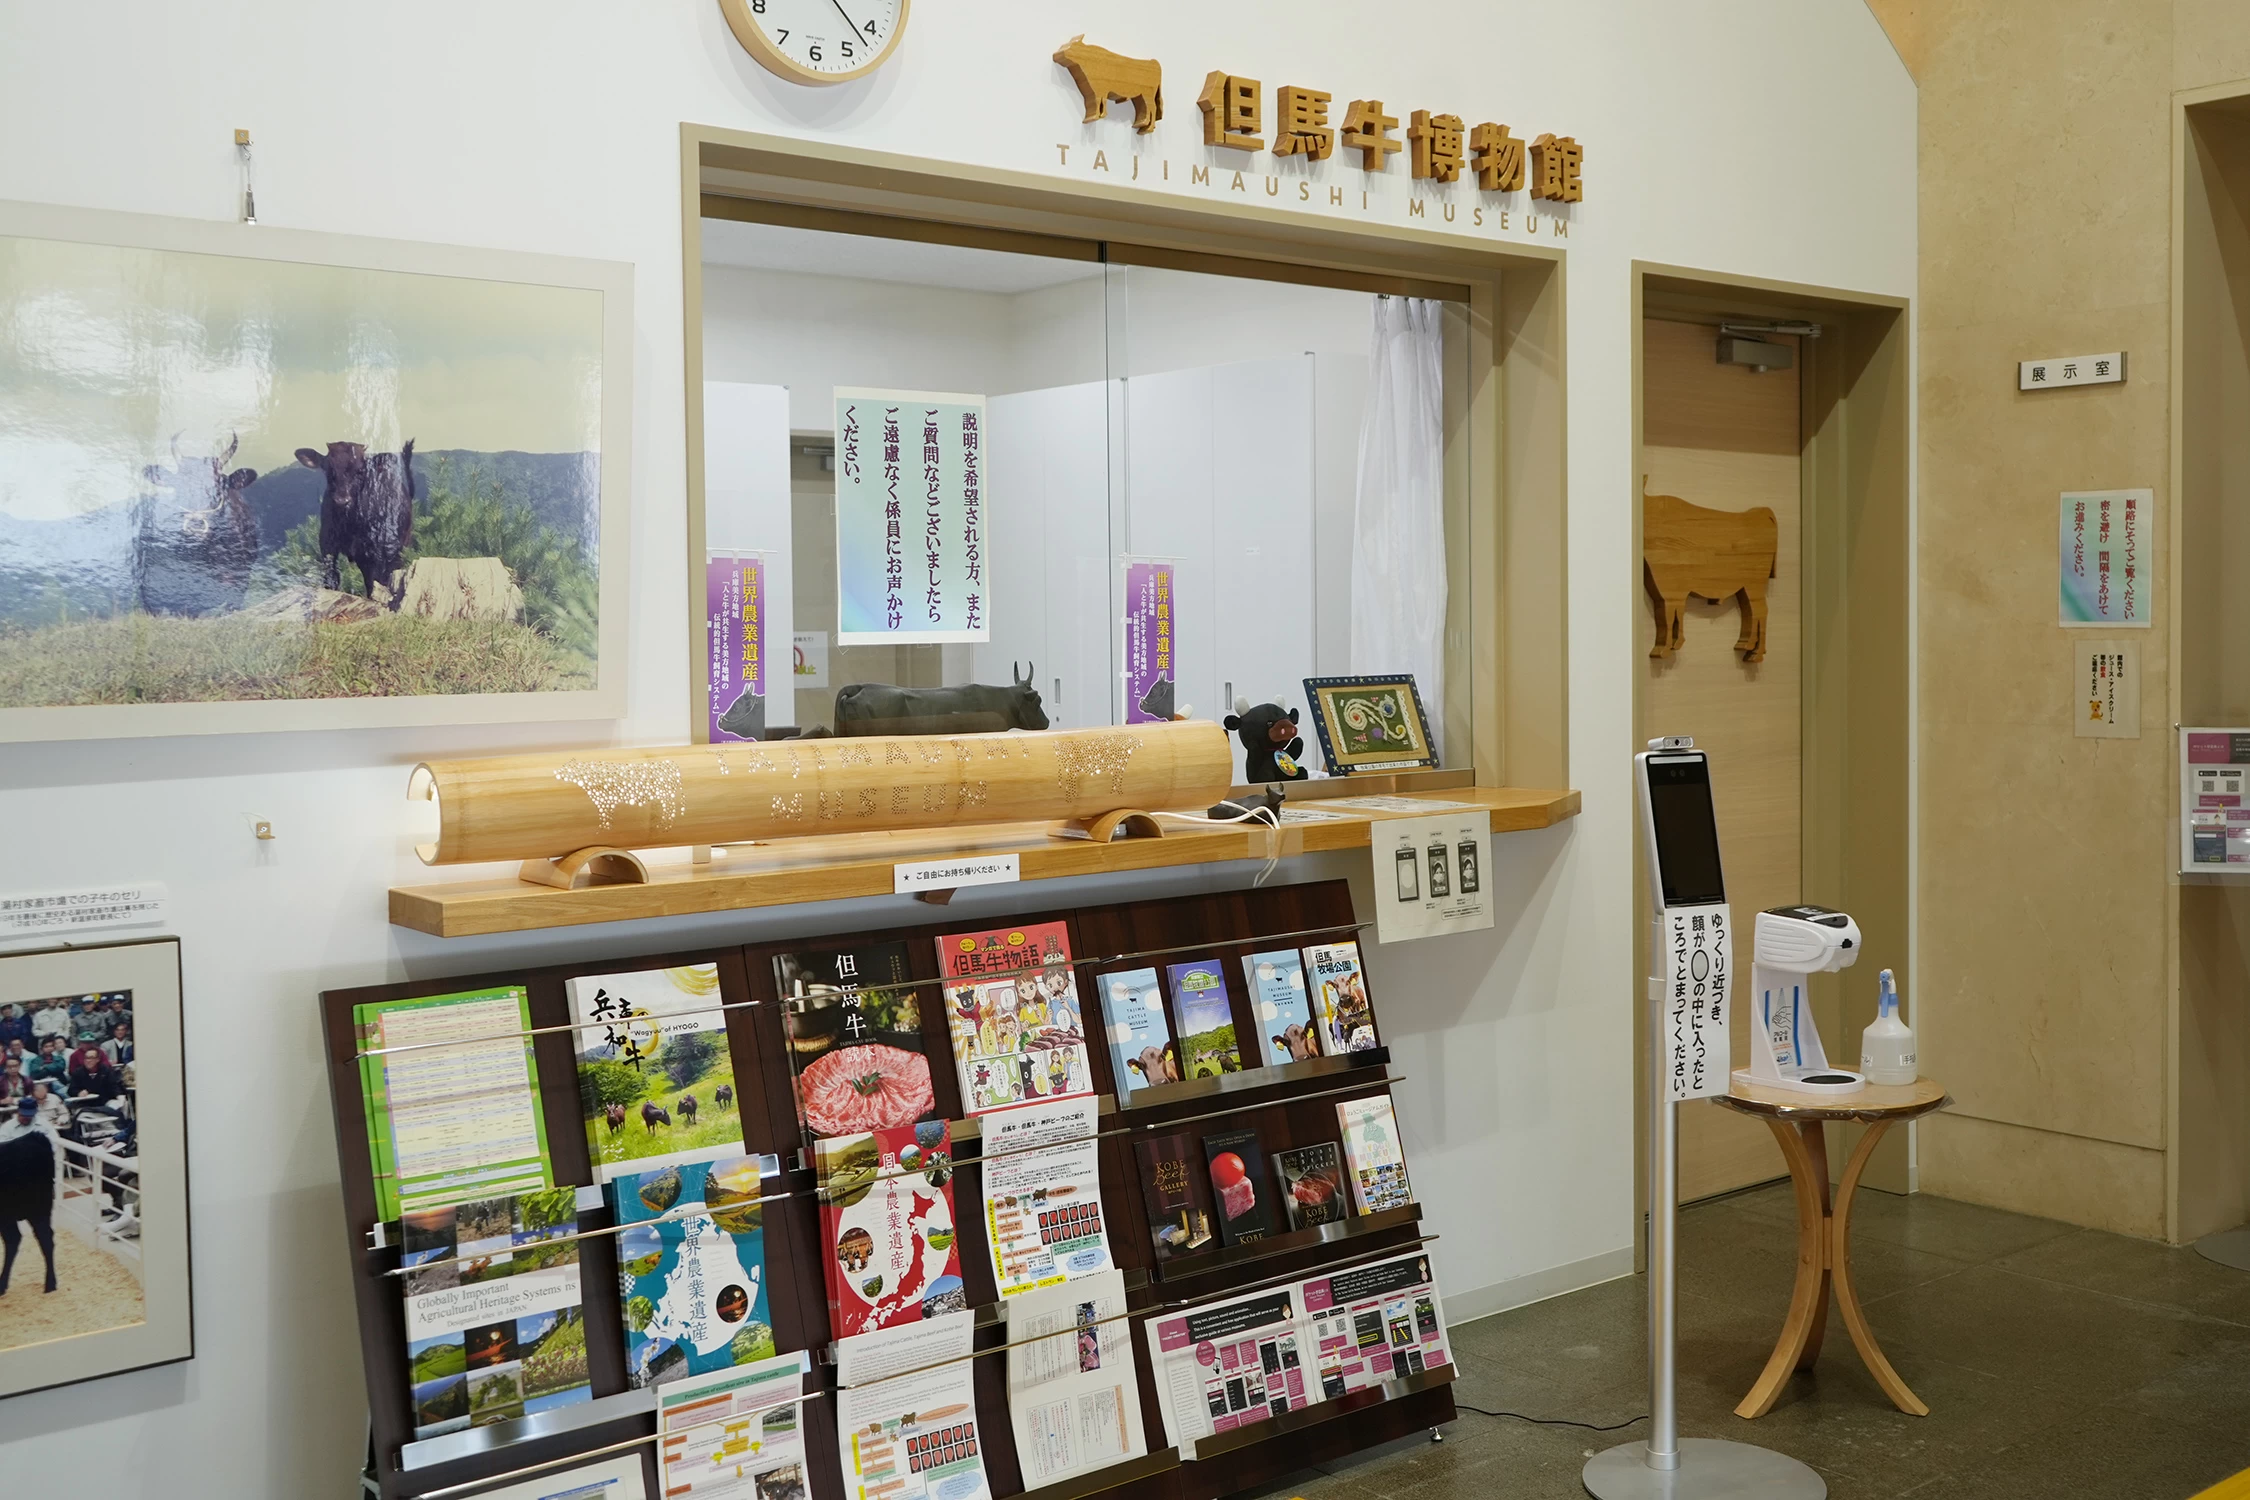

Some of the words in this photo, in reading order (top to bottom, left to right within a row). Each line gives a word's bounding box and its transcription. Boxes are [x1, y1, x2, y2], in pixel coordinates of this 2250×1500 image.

[777, 29, 789, 45] 7
[864, 20, 877, 35] 4
[810, 46, 822, 62] 6
[842, 41, 853, 58] 5
[1197, 70, 1584, 203] 但馬牛博物館
[1056, 144, 1369, 210] TAJIMAUSHI
[1409, 203, 1569, 239] MUSEUM
[2031, 361, 2110, 382] 展示室
[843, 405, 860, 484] ください。
[883, 407, 903, 630] ご遠慮なく係員にお声かけ
[922, 409, 941, 623] ご質問などございましたら
[2074, 501, 2085, 577] お進みください。
[2124, 499, 2136, 620] 順路にそってご覧ください
[2098, 551, 2109, 615] 間隔をあけて
[742, 567, 758, 681] 世界農業遺産
[1156, 572, 1170, 670] 世界農業遺産
[706, 736, 1031, 779] TAJIMAUSHI
[770, 781, 987, 824] MUSEUM
[916, 864, 1000, 881] ご自由にお持ち帰りください
[953, 944, 1039, 976] 但馬牛物語
[1315, 952, 1332, 964] 但馬
[1317, 960, 1352, 975] 牧場公園
[1711, 913, 1725, 1026] ゆっくり近づき、
[835, 954, 867, 1039] 但馬牛
[1673, 916, 1687, 1098] ころでとまってください。
[672, 1022, 699, 1032] HYOGO
[1156, 1160, 1186, 1173] KOBE
[1160, 1180, 1188, 1192] GALLERY
[882, 1152, 904, 1270] 日本農業遺産
[417, 1291, 460, 1310] Globally
[462, 1282, 509, 1302] Important
[680, 1216, 708, 1342] 世界農業遺産
[418, 1300, 477, 1324] Agricultural
[480, 1293, 520, 1312] Heritage
[522, 1284, 562, 1302] Systems
